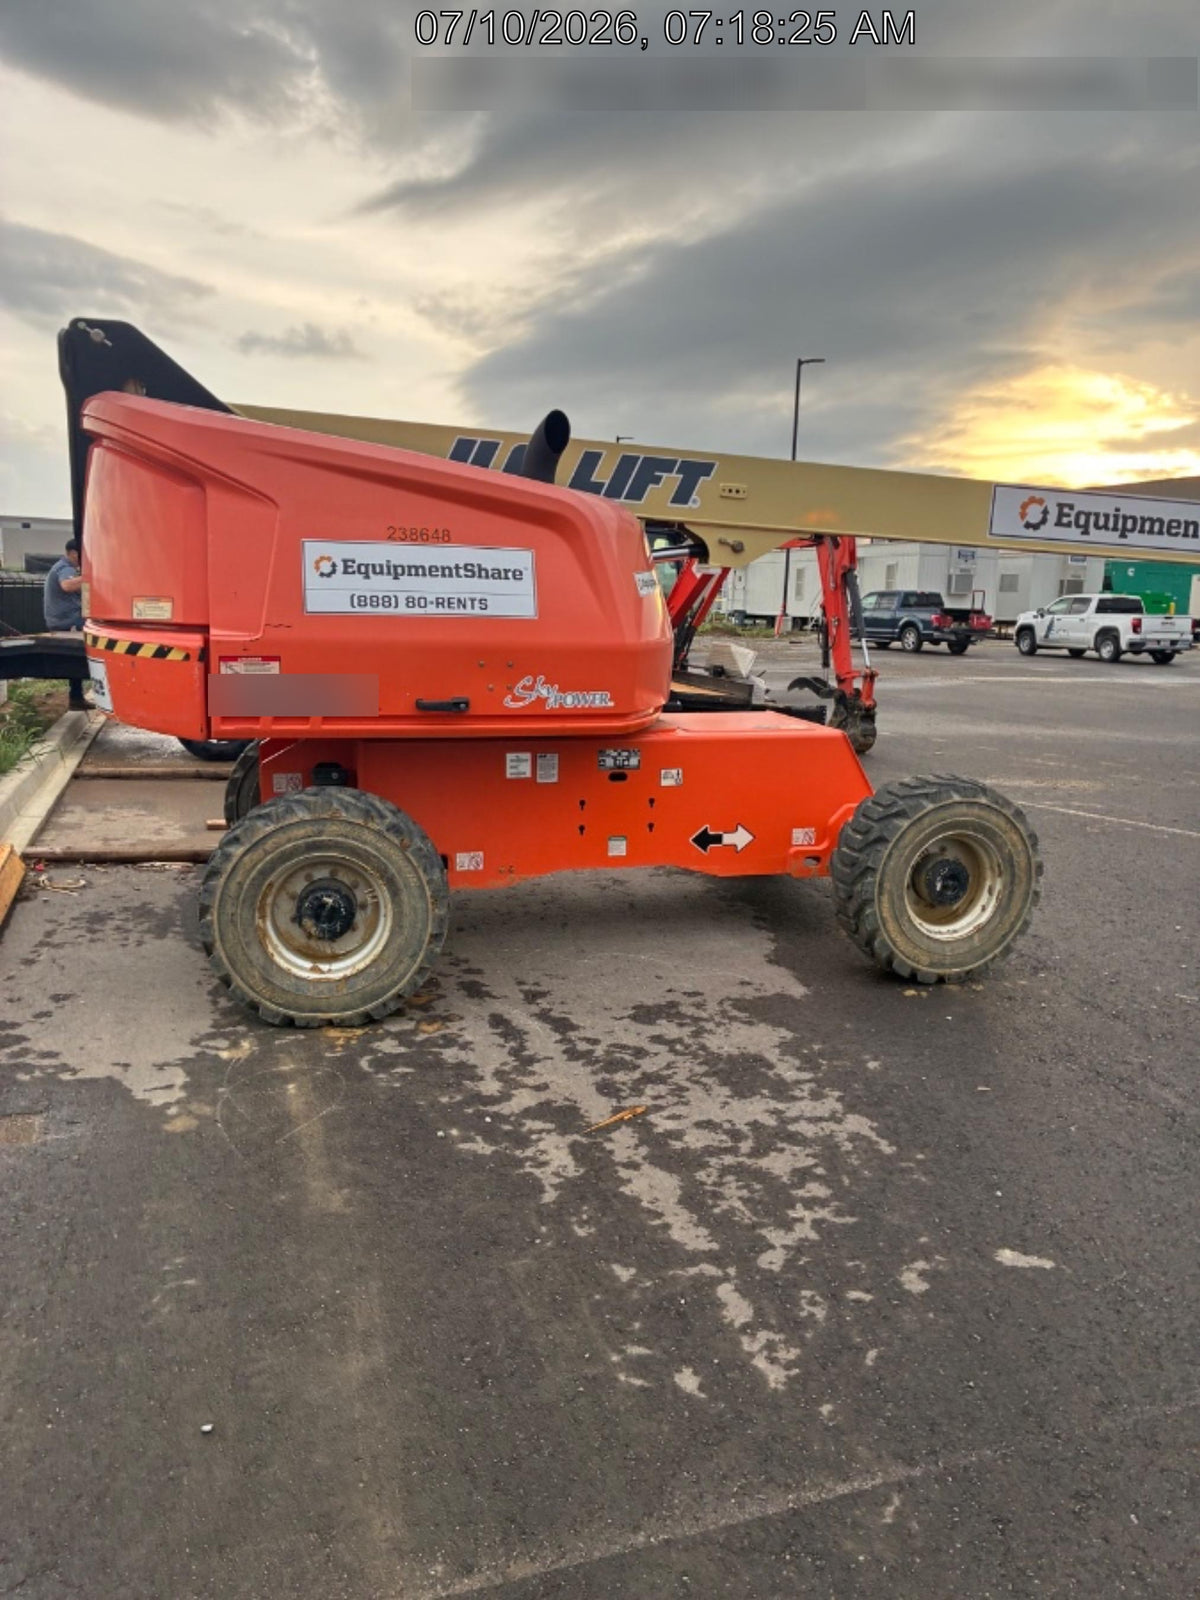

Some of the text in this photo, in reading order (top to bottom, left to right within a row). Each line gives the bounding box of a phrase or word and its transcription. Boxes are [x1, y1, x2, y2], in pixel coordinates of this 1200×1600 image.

[568, 449, 719, 507] LIFT
[1053, 502, 1200, 539] Equipmen
[386, 525, 451, 543] 238648
[341, 558, 524, 581] EquipmentShare
[350, 593, 489, 611] (888) 80-RENTS
[552, 691, 614, 708] POWER
